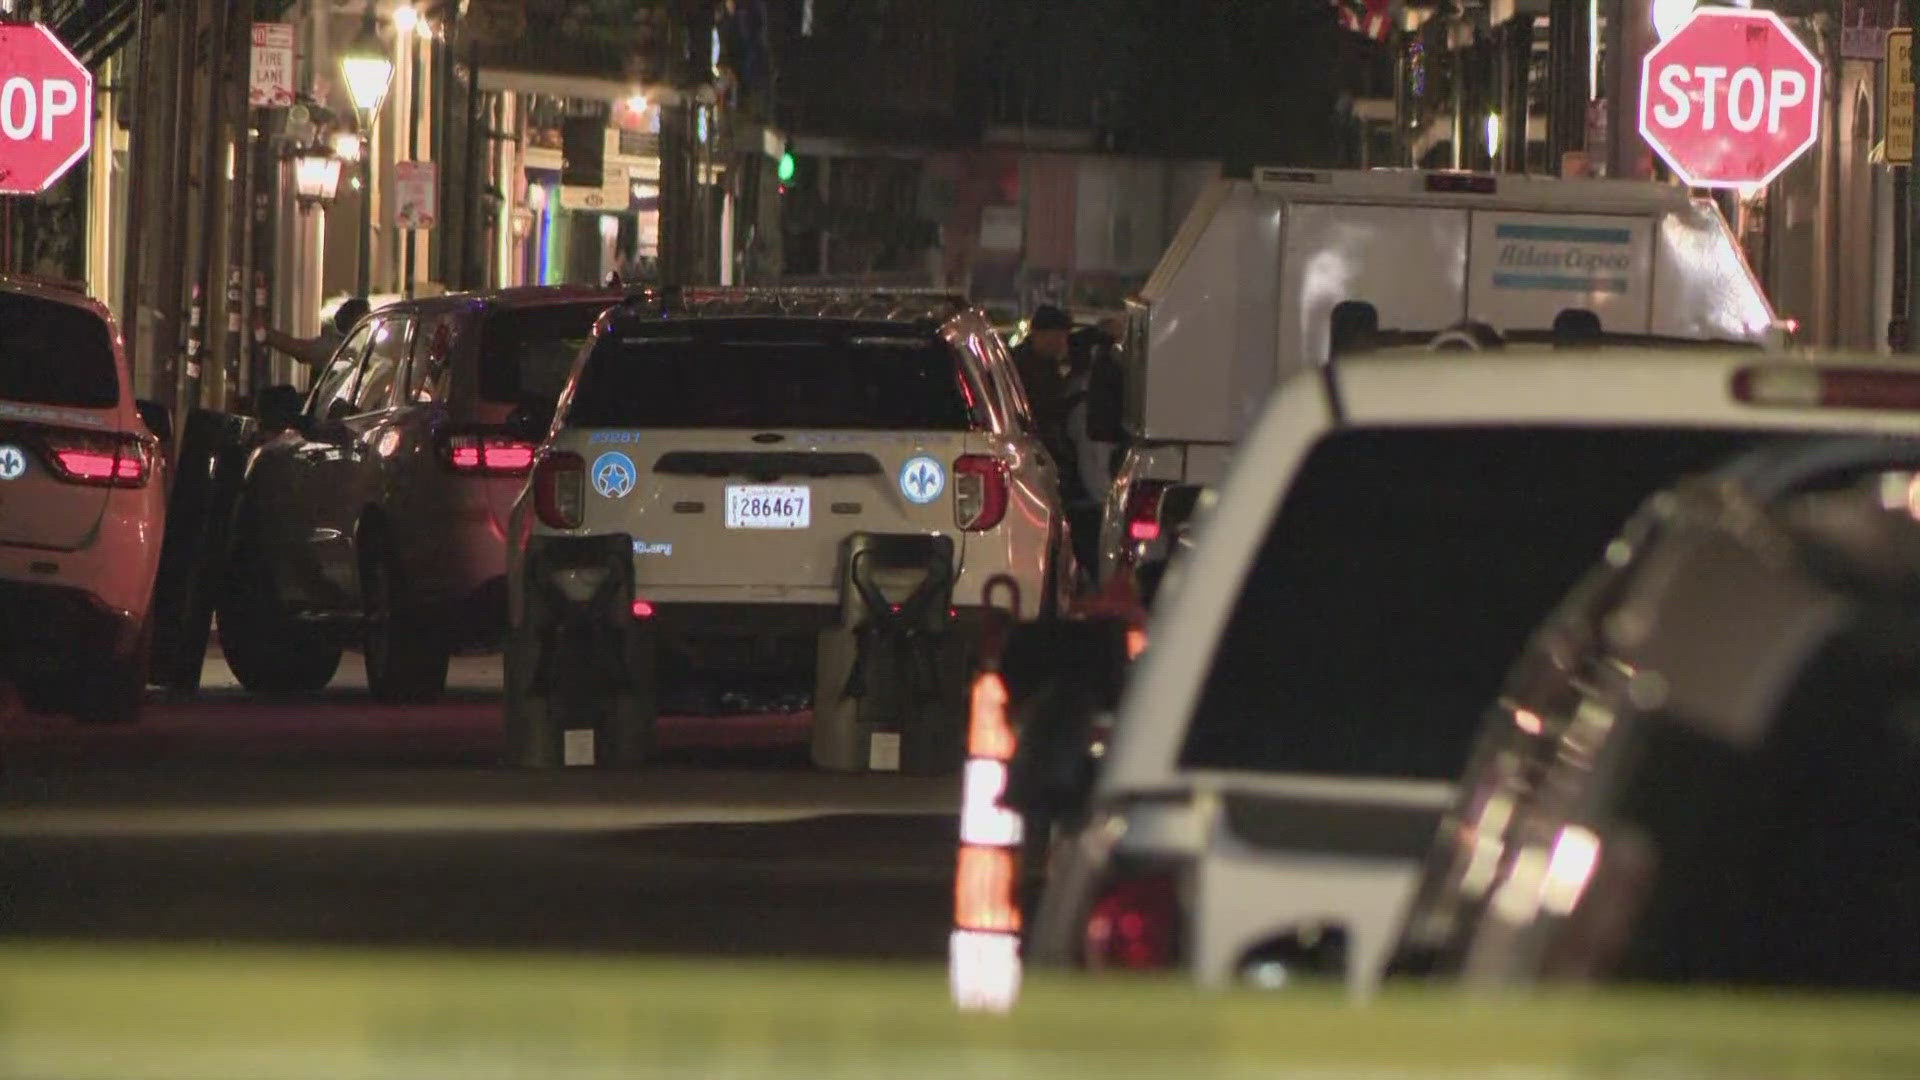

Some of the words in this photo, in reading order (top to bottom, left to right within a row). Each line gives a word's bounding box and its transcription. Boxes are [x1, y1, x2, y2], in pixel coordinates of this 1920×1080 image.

[257, 51, 282, 66] FIRE
[256, 70, 283, 85] LANE
[0, 76, 78, 142] OP
[1653, 63, 1807, 135] STOP
[740, 496, 804, 518] 286467
